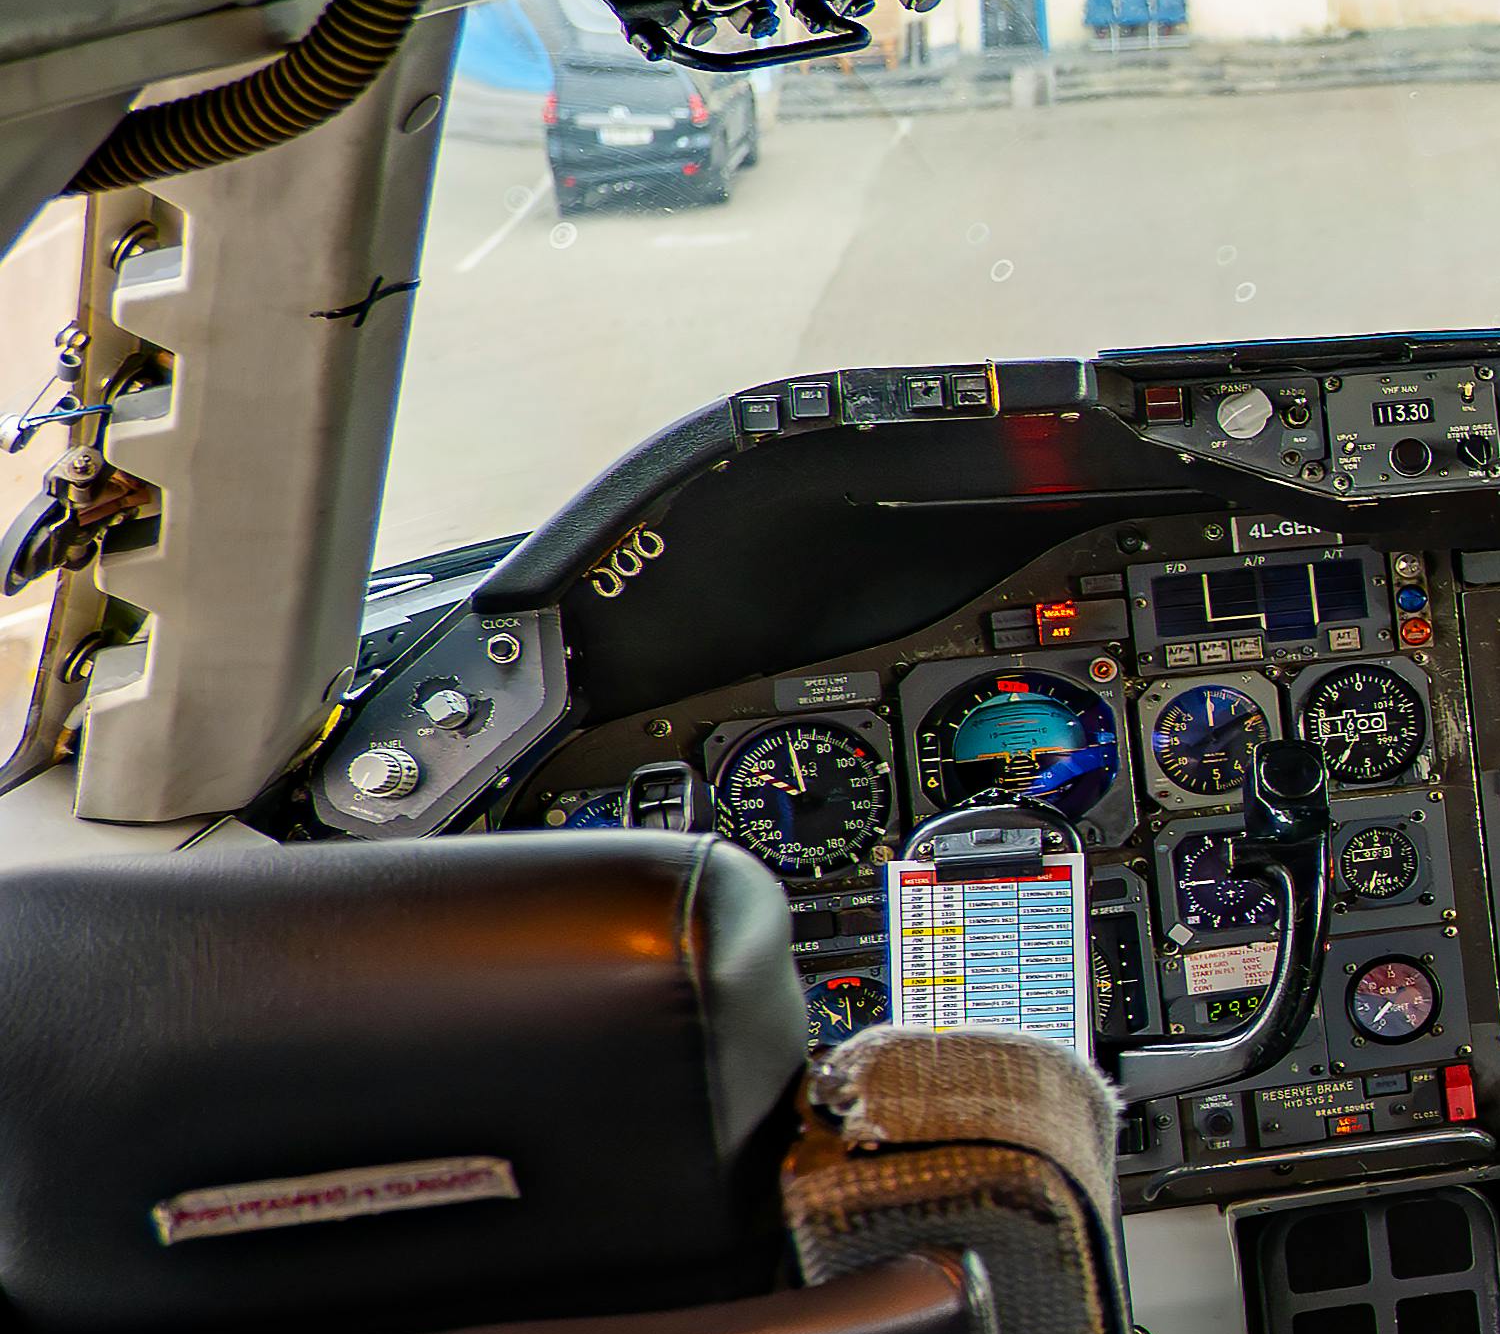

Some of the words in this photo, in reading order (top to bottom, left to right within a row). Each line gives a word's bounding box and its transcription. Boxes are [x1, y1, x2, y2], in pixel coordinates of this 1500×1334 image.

[1378, 404, 1428, 423] 113.30
[1323, 549, 1343, 559] A/T
[1244, 556, 1265, 566] A/P
[482, 618, 520, 629] CLOCK
[370, 740, 405, 749] PANEL
[836, 758, 855, 768] 100
[850, 778, 868, 787] 120
[742, 799, 764, 809] 300
[851, 800, 870, 810] 140
[750, 820, 772, 830] 250
[845, 820, 864, 829] 160
[758, 831, 782, 841] 240
[779, 843, 801, 853] 220
[826, 838, 845, 848] 180
[802, 847, 824, 857] 200
[1263, 1087, 1312, 1101] RESERVE
[1318, 1081, 1354, 1094] BRAKE
[1316, 1107, 1342, 1116] BRAKE
[1345, 1103, 1374, 1113] SOURCE
[1413, 1111, 1438, 1119] CLOSE
